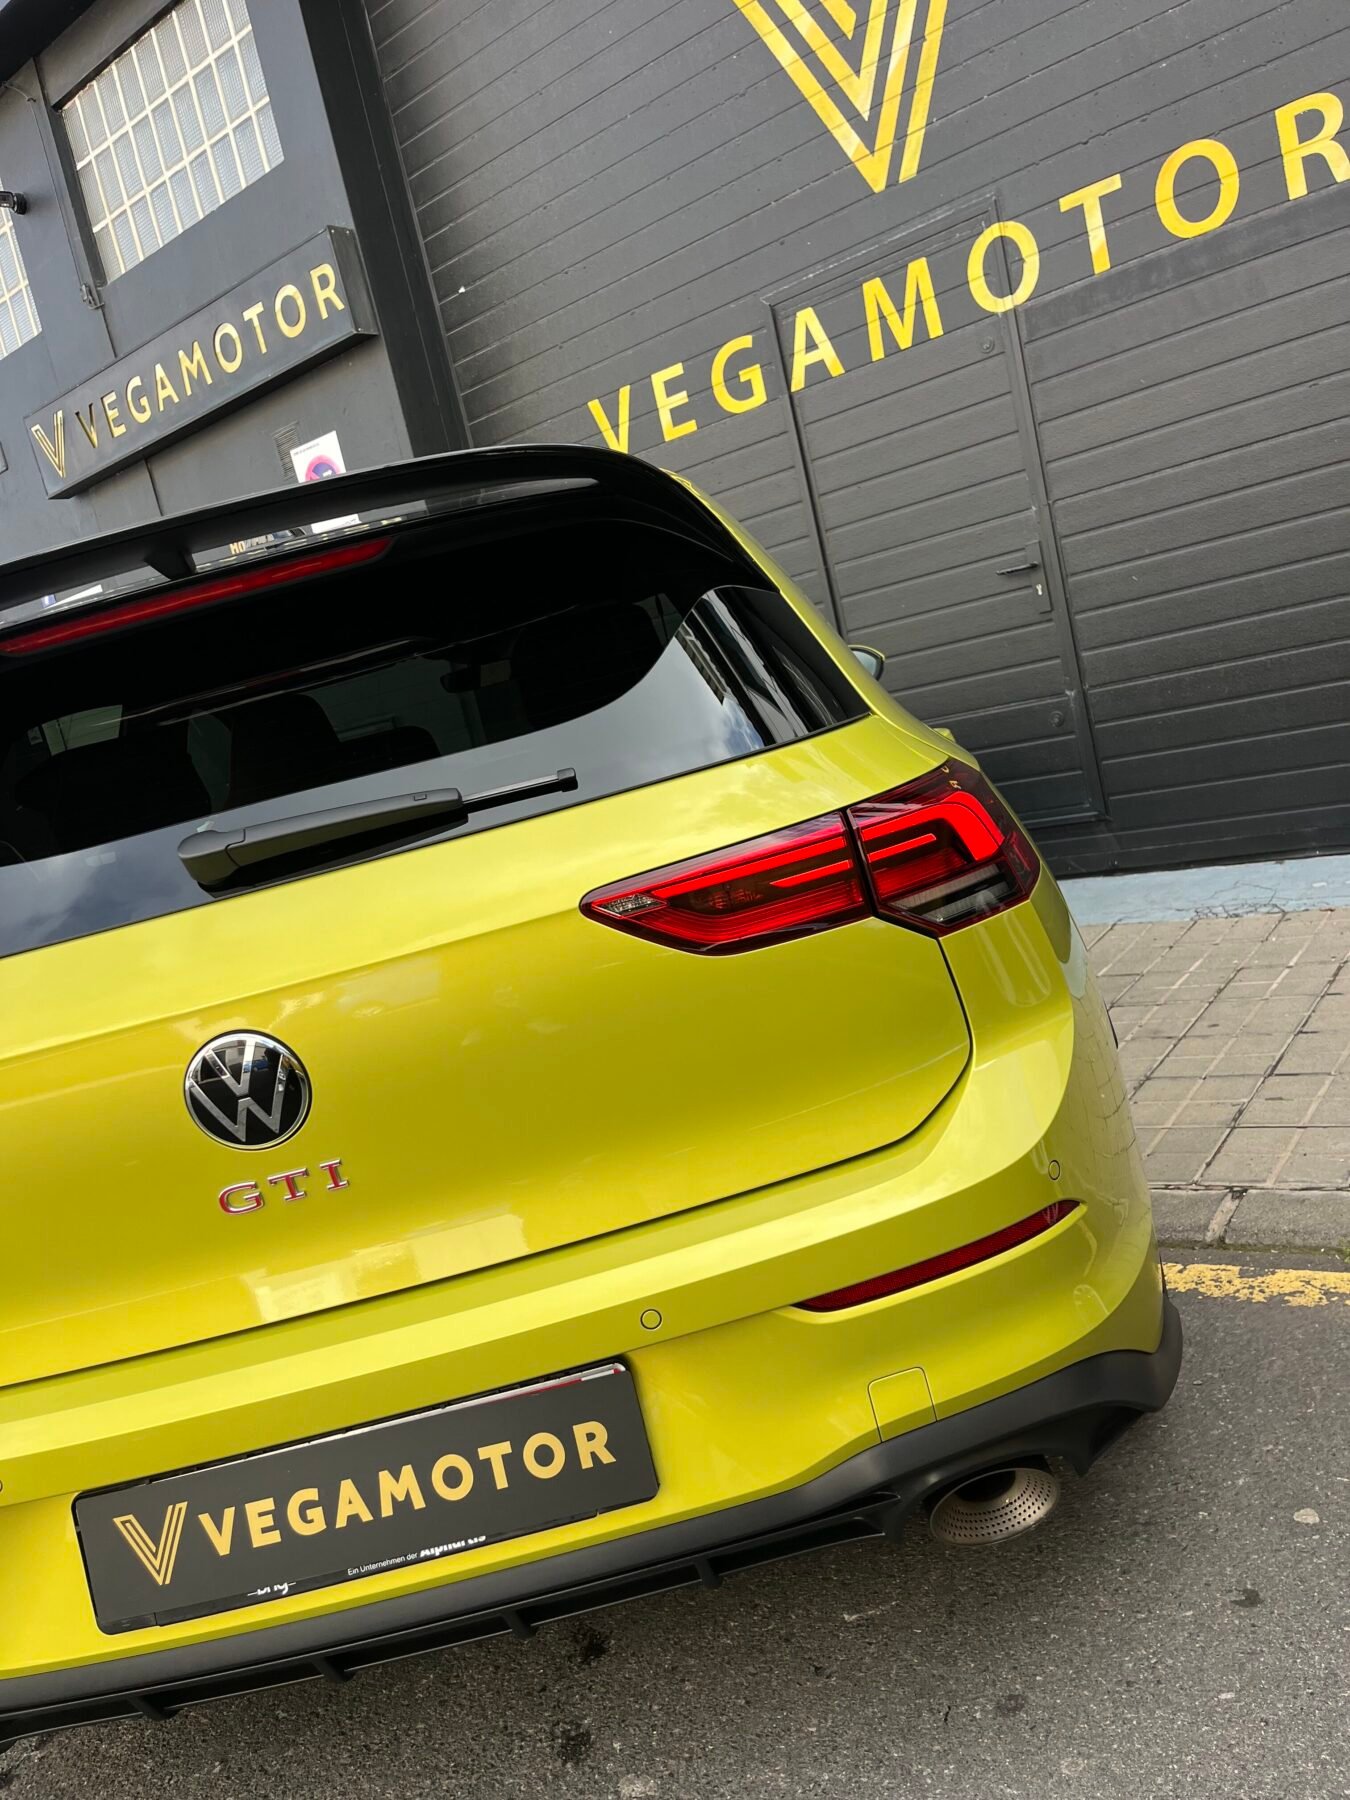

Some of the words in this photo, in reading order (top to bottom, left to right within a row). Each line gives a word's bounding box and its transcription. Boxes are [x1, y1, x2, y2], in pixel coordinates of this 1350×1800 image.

[587, 92, 1350, 454] VEGAMOTOR
[75, 263, 345, 448] VEGAMOTOR
[219, 1158, 349, 1215] GTI
[197, 1420, 617, 1556] VEGAMOTOR
[347, 1567, 359, 1576] Ein
[360, 1556, 405, 1573] Unternehmen
[406, 1552, 418, 1561] der
